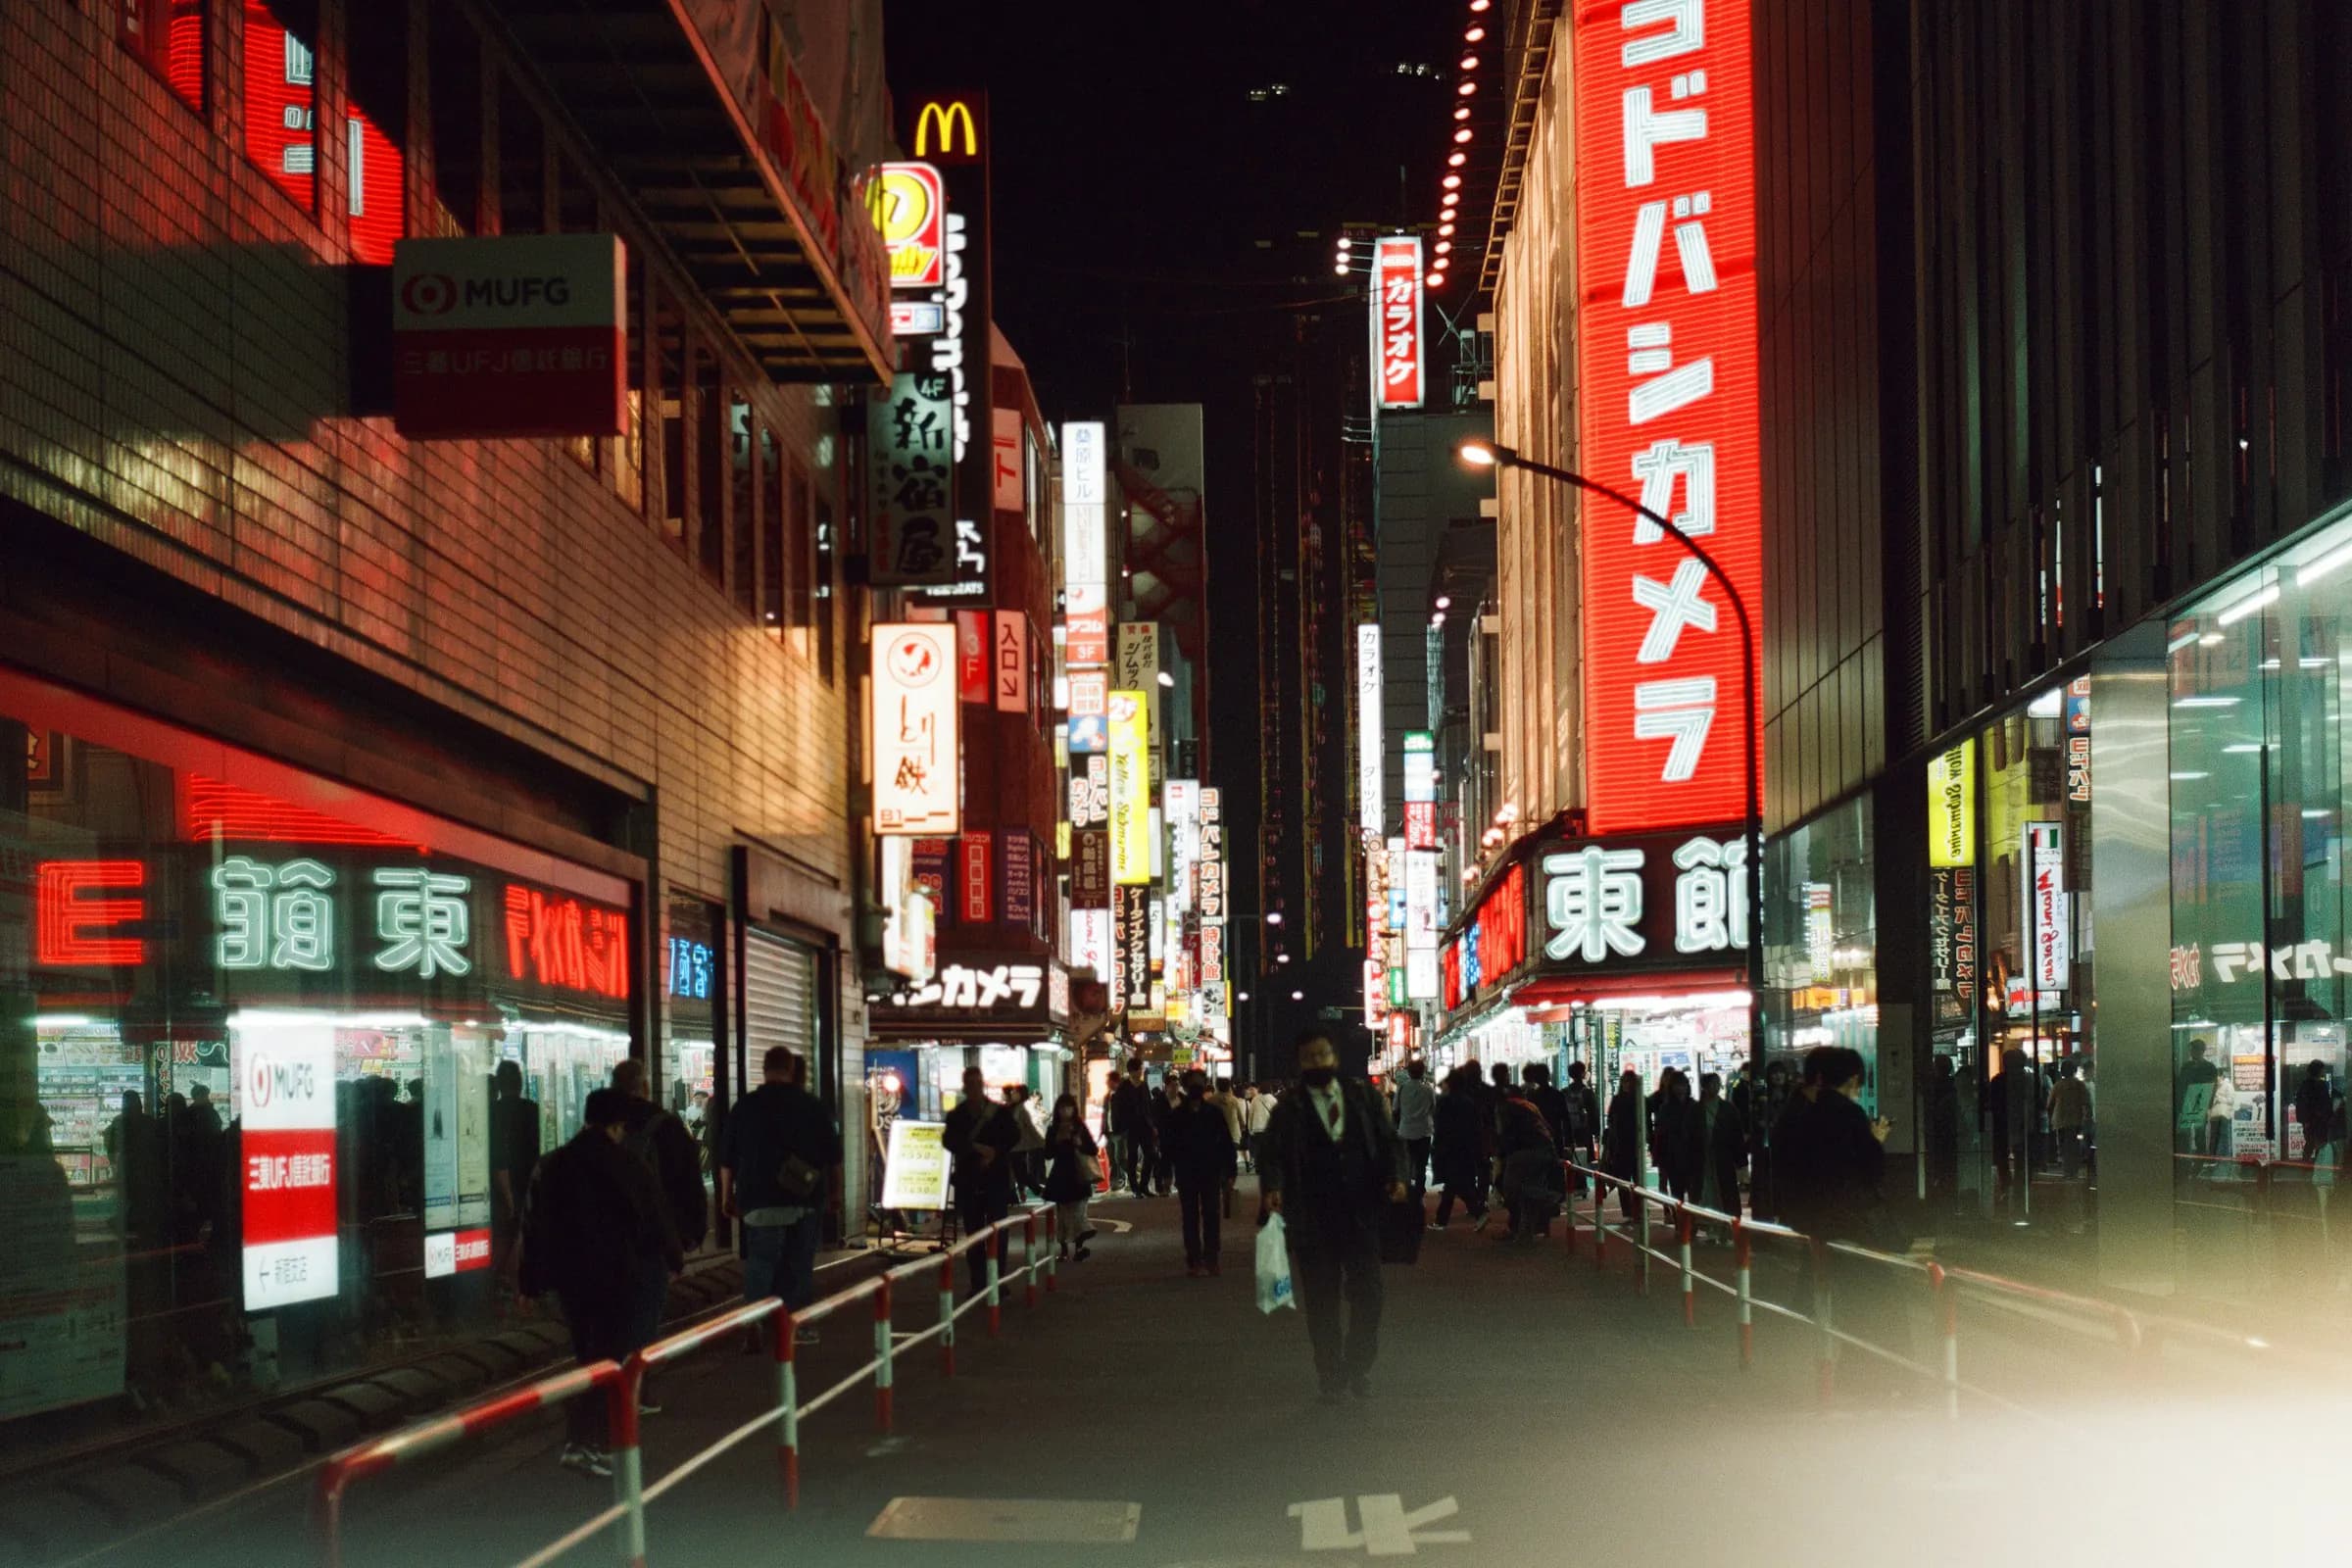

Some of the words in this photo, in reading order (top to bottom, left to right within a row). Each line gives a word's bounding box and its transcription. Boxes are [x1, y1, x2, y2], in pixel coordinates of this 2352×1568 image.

[465, 277, 568, 308] MUFG
[1386, 276, 1415, 386] カラオケ
[1620, 0, 1718, 782] ヨドバシカメラ
[1070, 777, 1090, 828] カメラ
[1199, 787, 1221, 915] ヨドバシカメラ
[1203, 925, 1221, 980] 時計館
[273, 1063, 315, 1101] MUFG
